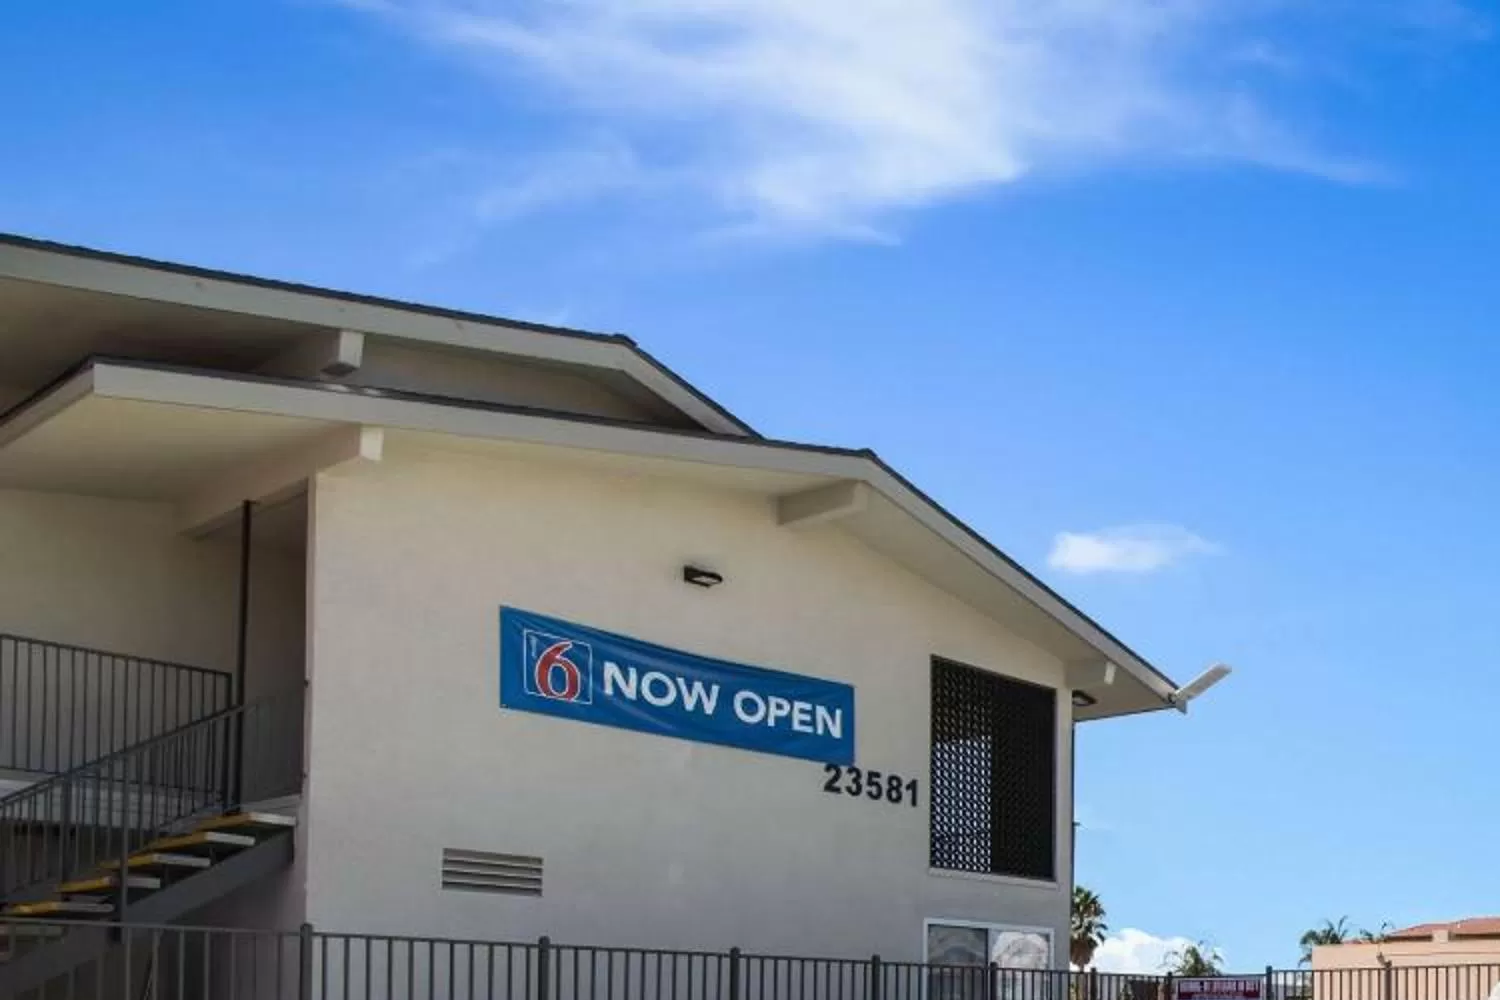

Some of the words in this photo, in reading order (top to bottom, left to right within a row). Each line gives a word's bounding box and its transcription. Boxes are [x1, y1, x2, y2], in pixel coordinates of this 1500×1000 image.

[534, 639, 582, 702] 6
[602, 660, 720, 716] NOW
[733, 689, 843, 739] OPEN
[823, 763, 919, 807] 23581
